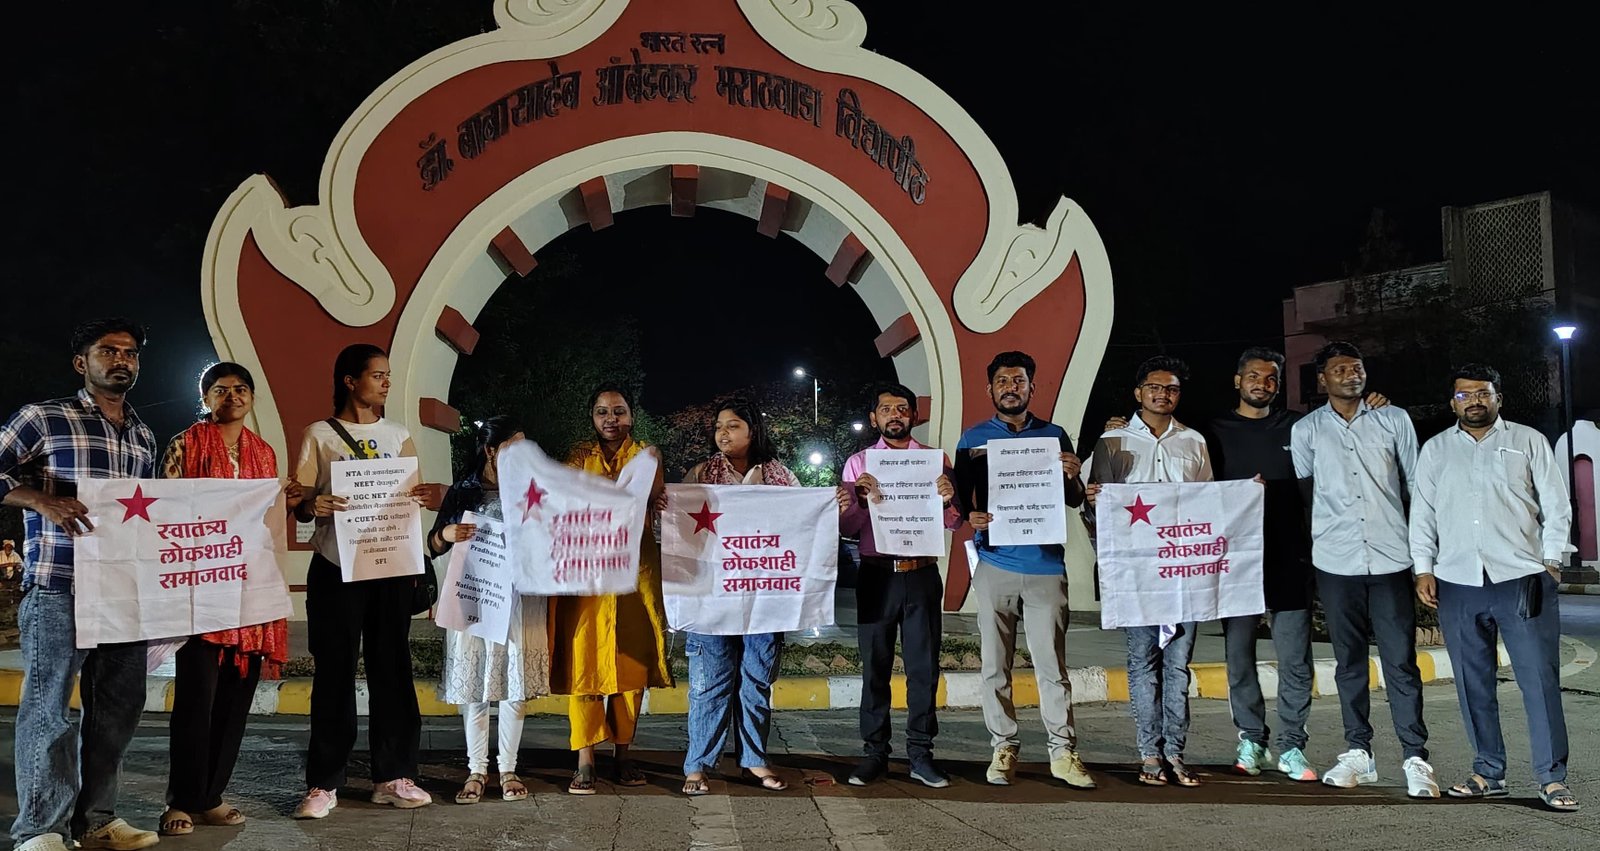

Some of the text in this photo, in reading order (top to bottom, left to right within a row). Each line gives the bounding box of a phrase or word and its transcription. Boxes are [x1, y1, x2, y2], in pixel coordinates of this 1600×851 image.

[640, 31, 726, 54] भारत रत्न
[714, 65, 823, 128] मराठवाडा
[836, 88, 931, 205] विद्यापीठ
[157, 516, 227, 539] स्वातंत्र्य
[354, 514, 389, 523] CUET-UG
[1156, 519, 1212, 539] स्वातंत्र्य
[159, 535, 243, 564] लोकशाही
[722, 530, 780, 550] स्वातंत्र्य
[1158, 536, 1229, 559] लोकशाही
[470, 544, 497, 557] Pradhan
[722, 550, 797, 571] लोकशाही
[159, 563, 248, 589] समाजवाद
[1158, 559, 1230, 579] समाजवाद
[464, 573, 492, 586] Dissolve
[723, 576, 802, 592] समाजवाद
[454, 581, 506, 602] National Testing
[455, 591, 481, 603] Agency
[467, 614, 480, 623] SFI
